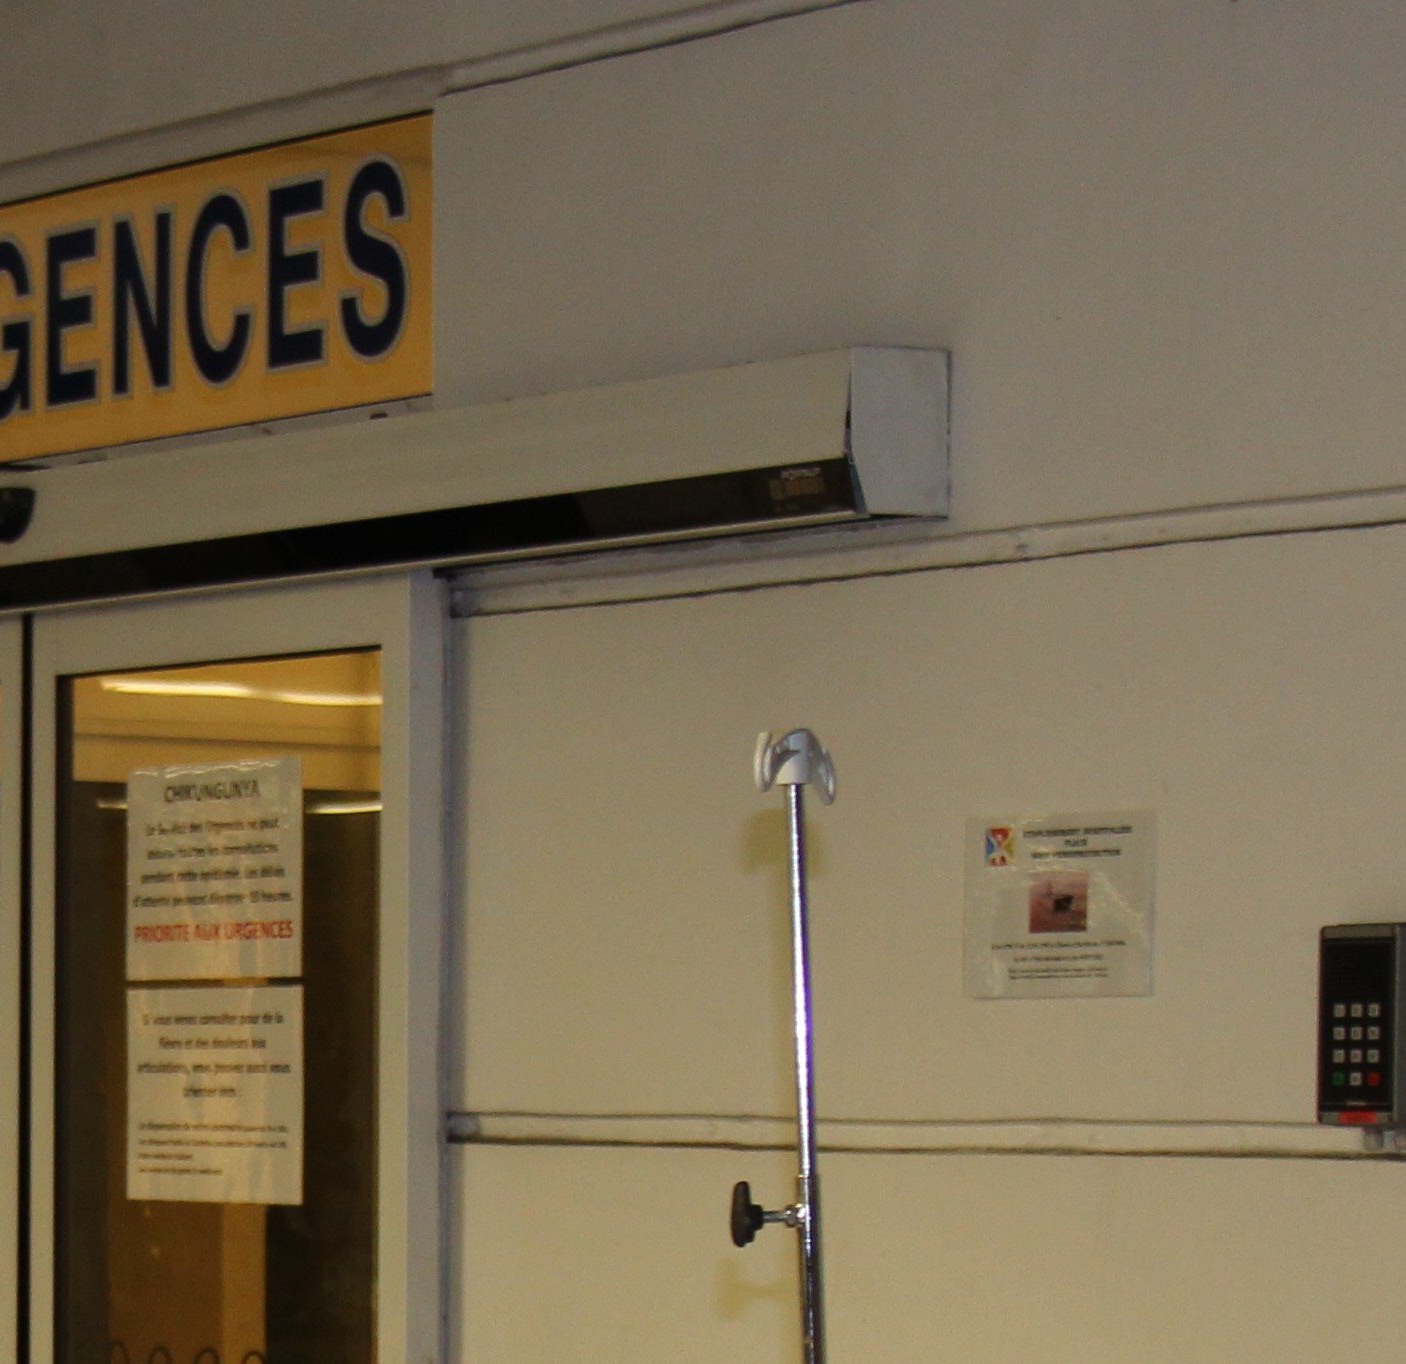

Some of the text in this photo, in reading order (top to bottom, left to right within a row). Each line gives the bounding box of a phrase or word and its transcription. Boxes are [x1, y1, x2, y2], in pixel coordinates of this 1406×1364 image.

[164, 779, 261, 803] CHIKUNGUNYA
[194, 922, 220, 940] AUX
[224, 920, 294, 940] URGENCES
